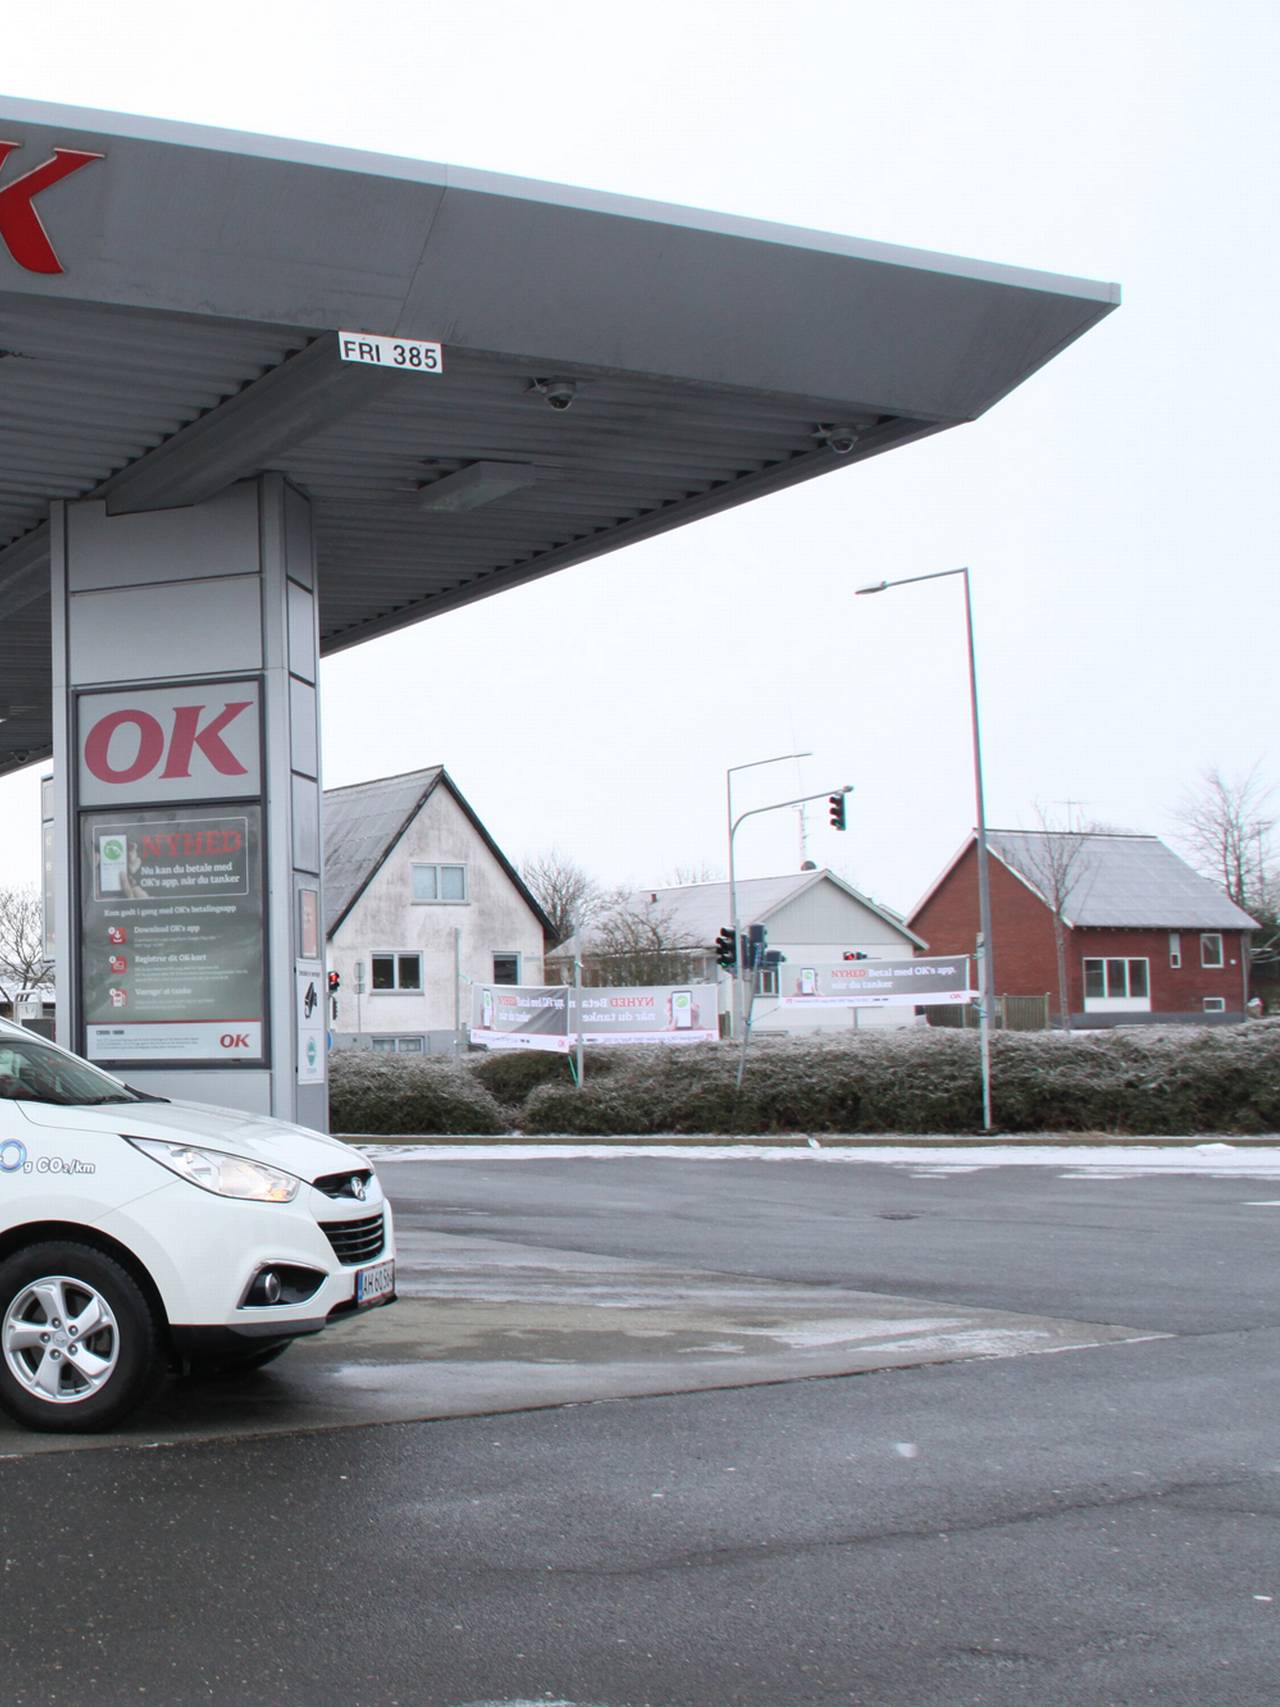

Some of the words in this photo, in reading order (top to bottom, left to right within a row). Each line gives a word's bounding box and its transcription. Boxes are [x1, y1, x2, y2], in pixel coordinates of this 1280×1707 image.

[343, 340, 381, 362] FRI
[392, 345, 438, 369] 385
[84, 701, 254, 784] OK
[142, 830, 242, 859] NYHED
[155, 865, 172, 875] kan
[173, 864, 185, 874] du
[186, 862, 212, 874] betale
[213, 861, 233, 872] med
[197, 874, 209, 884] du
[210, 873, 240, 884] tanker
[894, 966, 913, 977] med
[914, 965, 936, 976] OK's
[219, 1034, 250, 1048] OK
